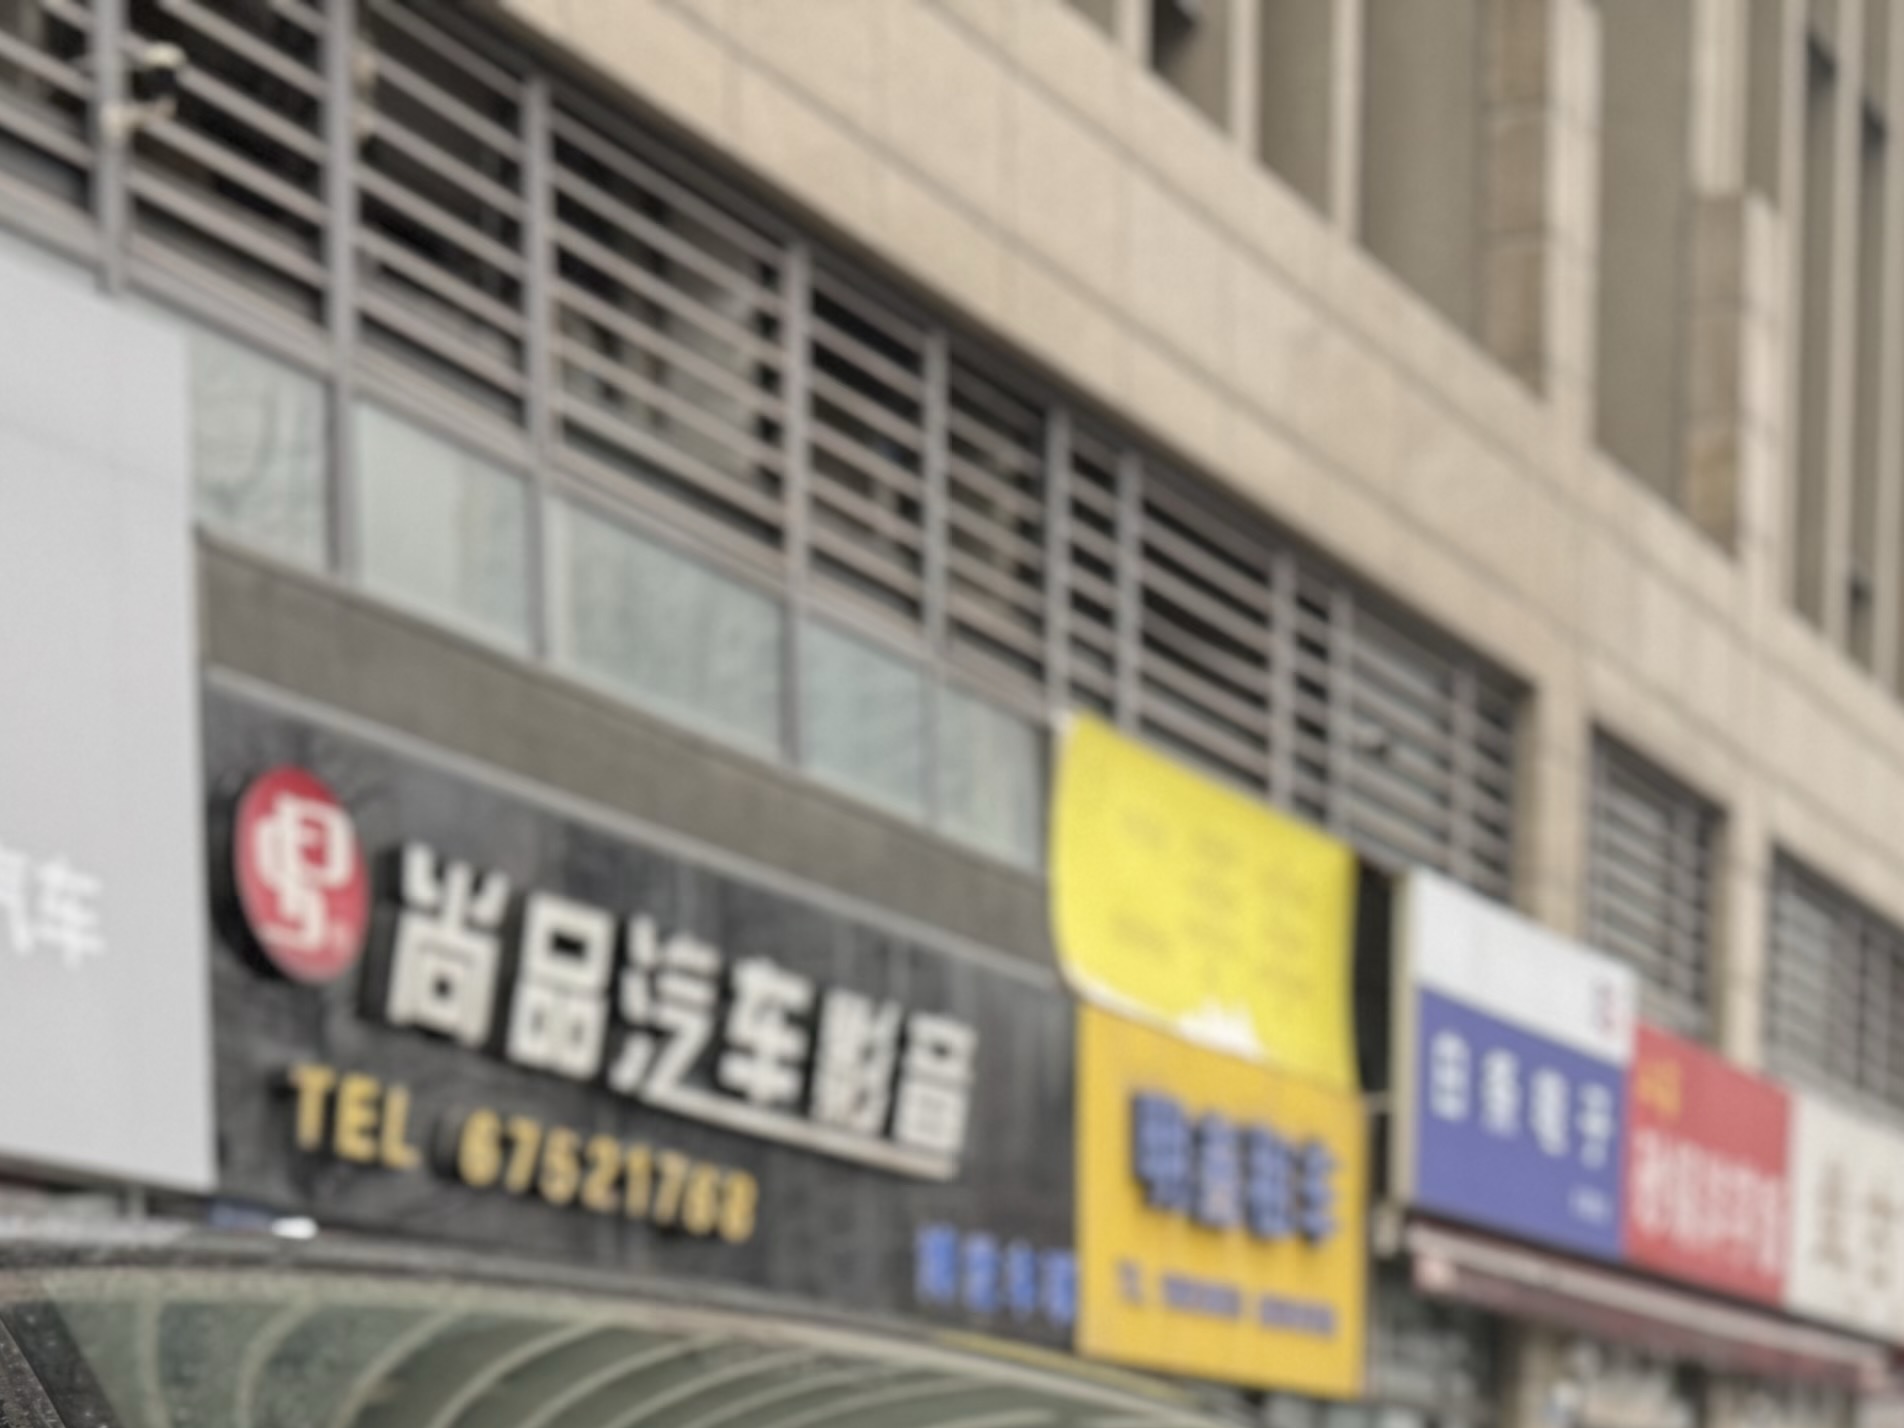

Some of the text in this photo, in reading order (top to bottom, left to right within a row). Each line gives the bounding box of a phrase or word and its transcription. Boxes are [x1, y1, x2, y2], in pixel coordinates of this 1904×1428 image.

[290, 1064, 420, 1170] TEL
[386, 842, 977, 1178] 尚品汽车影音
